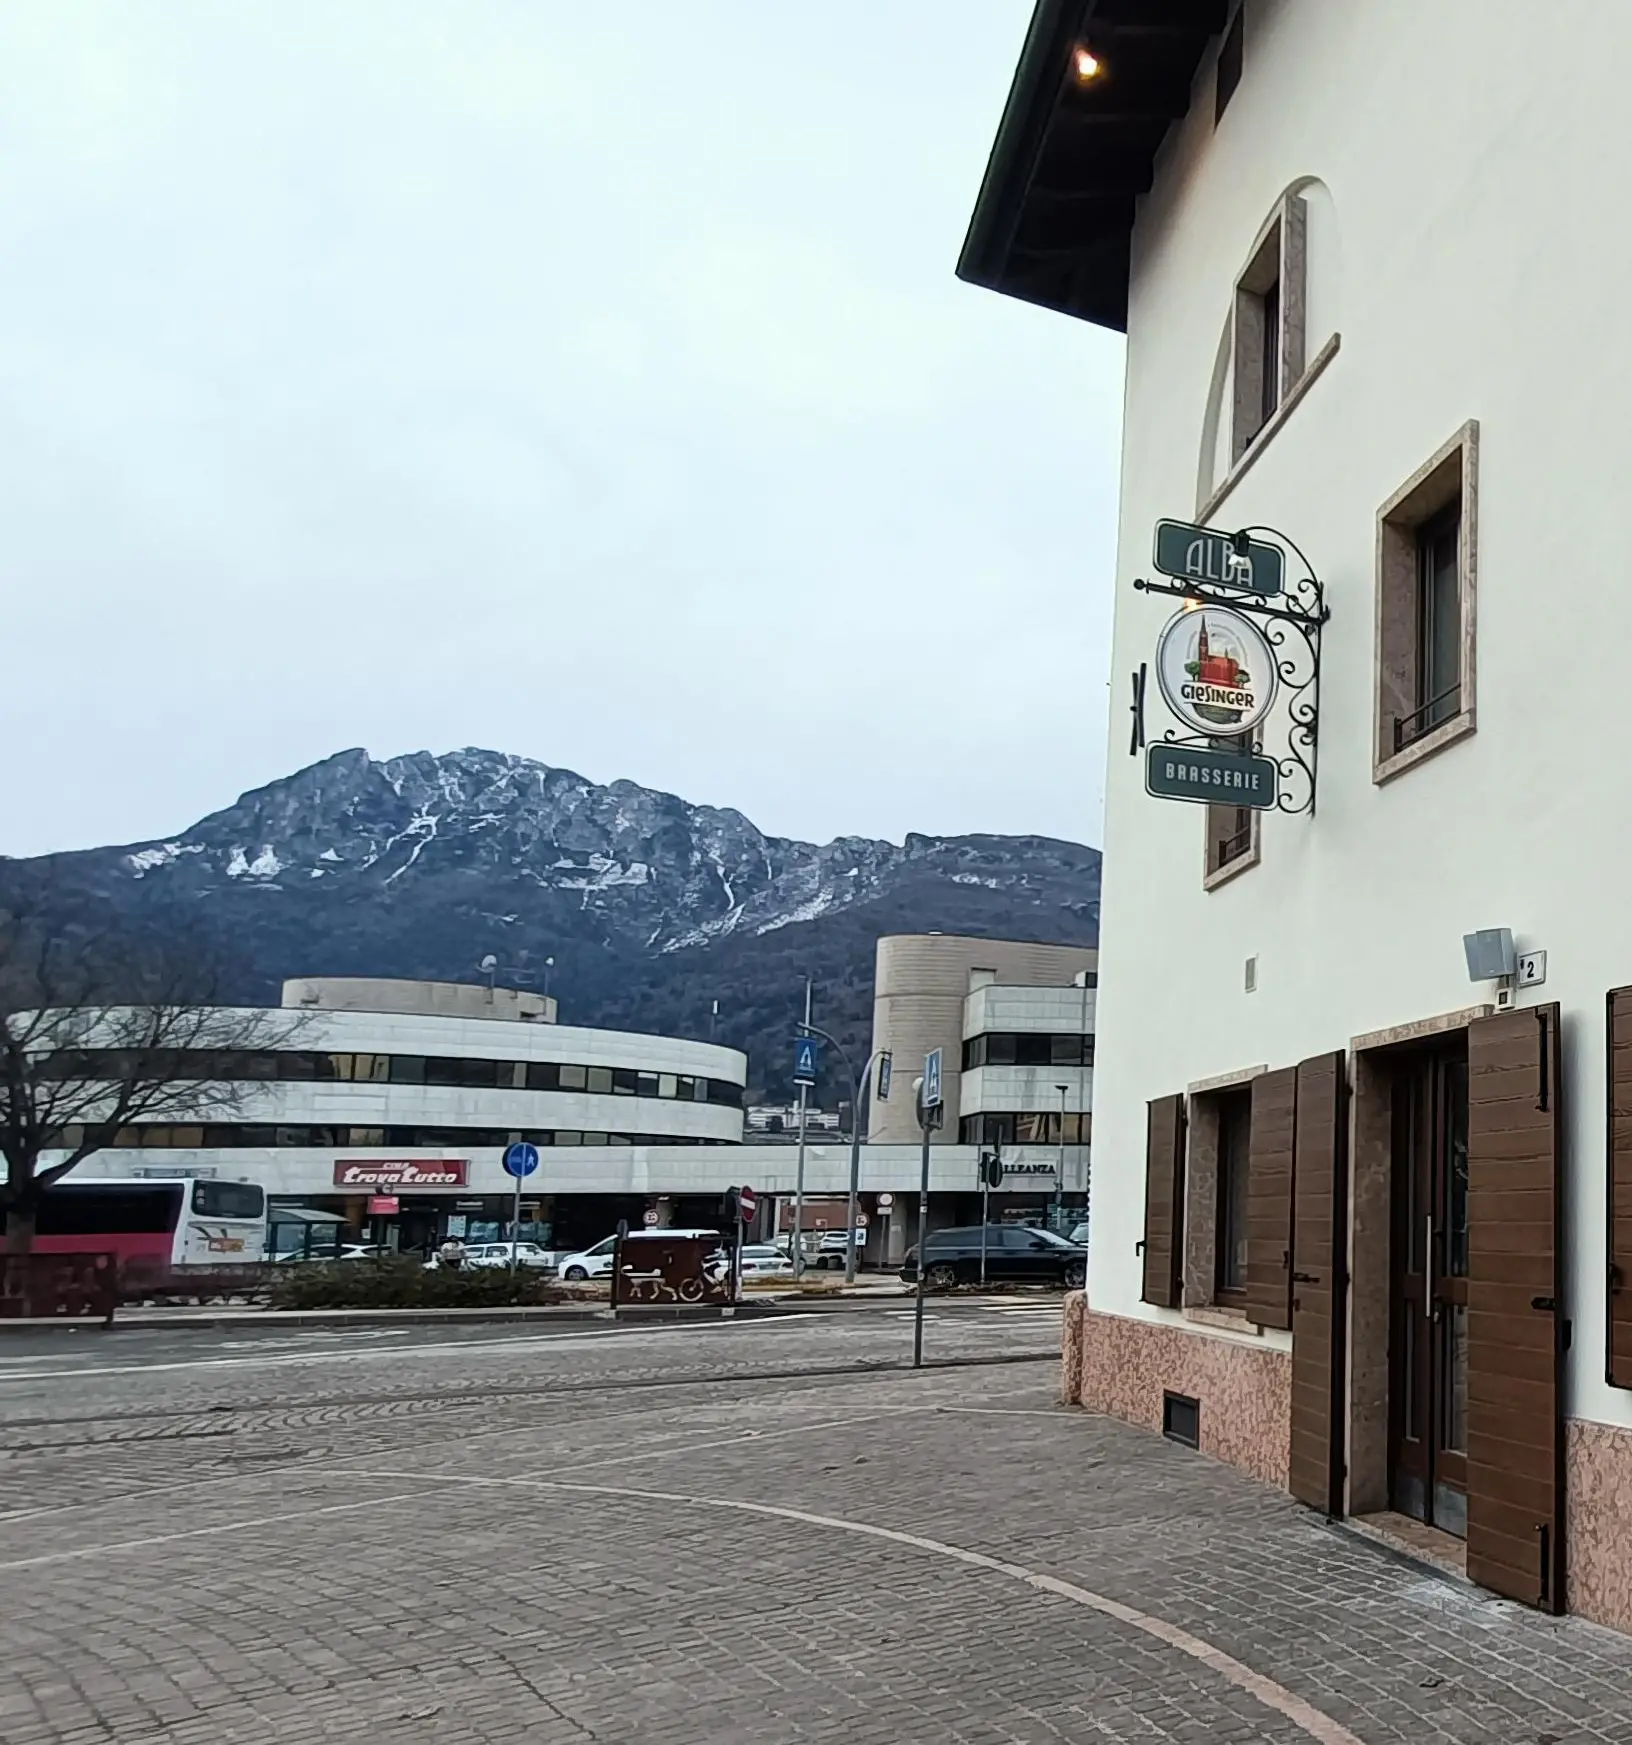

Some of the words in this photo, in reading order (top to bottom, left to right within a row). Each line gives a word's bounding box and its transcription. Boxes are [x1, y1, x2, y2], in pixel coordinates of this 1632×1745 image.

[1165, 761, 1260, 790] BRASSERIE
[1527, 960, 1534, 979] 2
[1003, 1164, 1056, 1174] LLEANZA
